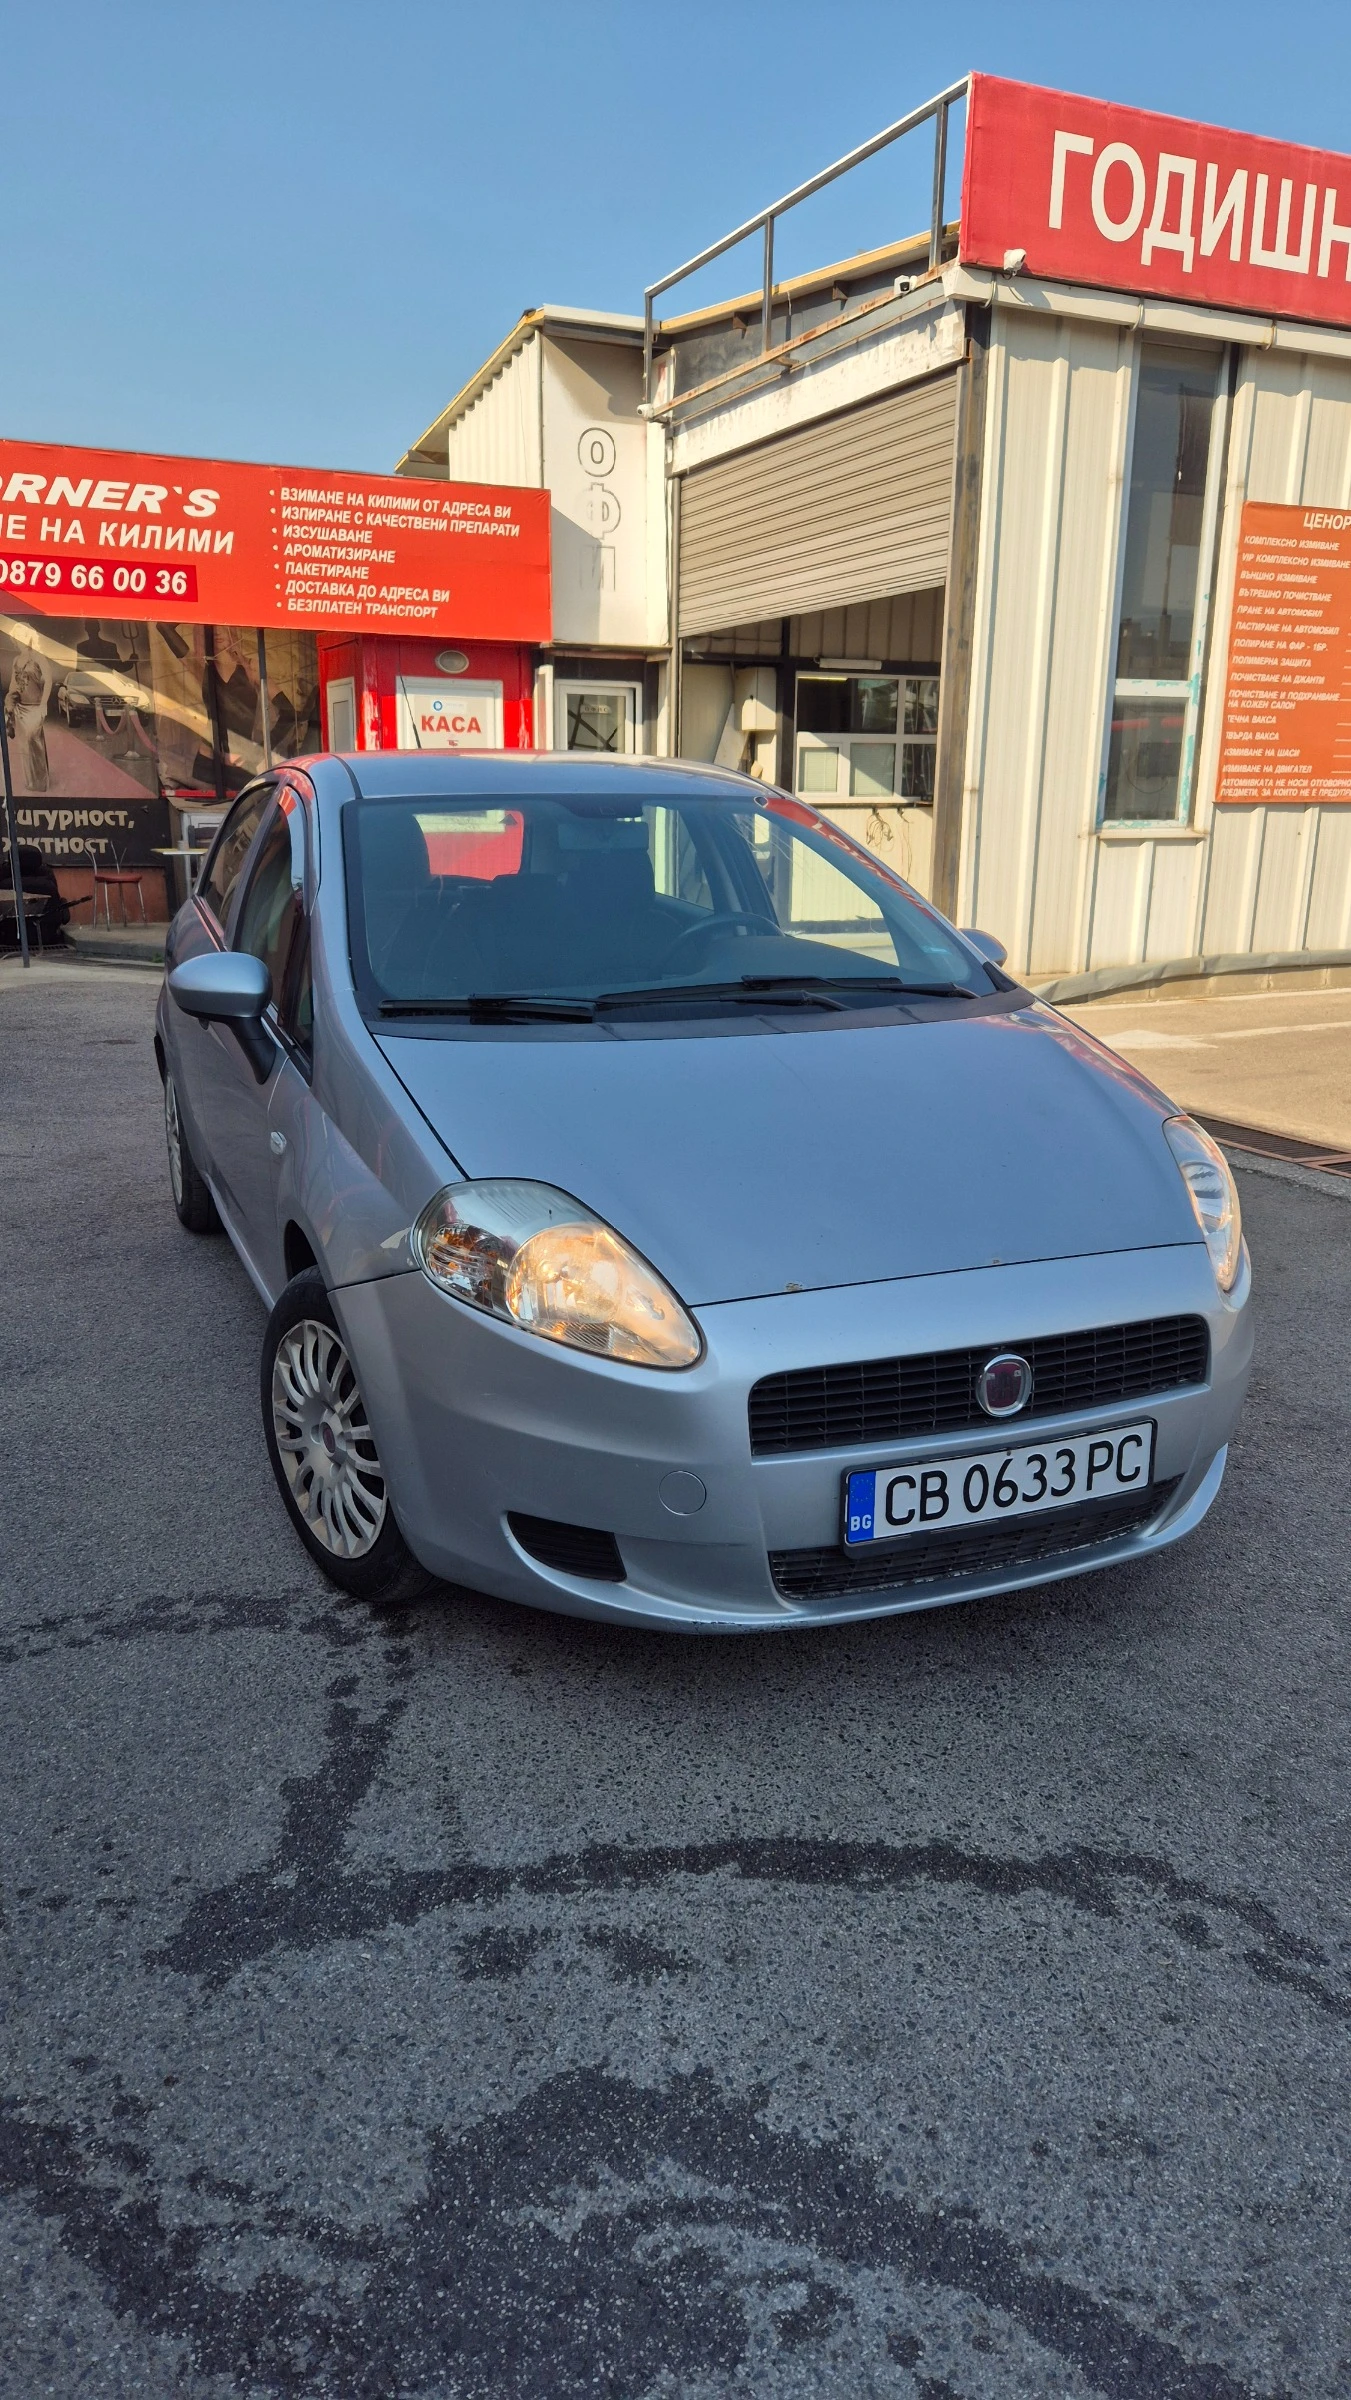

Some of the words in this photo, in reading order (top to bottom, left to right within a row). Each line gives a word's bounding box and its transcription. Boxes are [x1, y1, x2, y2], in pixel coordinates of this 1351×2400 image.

[1048, 130, 1351, 282] ГОДИШН
[0, 472, 221, 518] RNER`S
[280, 487, 344, 505] ВЗИМАНЕ
[347, 493, 364, 507] НА
[368, 494, 420, 511] КИЛИМИ
[422, 500, 440, 513] ОТ
[442, 502, 491, 517] АДРЕСА
[494, 505, 512, 519] ВИ
[281, 506, 351, 524] ИЗПИРАНЕ
[354, 511, 364, 524] С
[366, 514, 447, 532] КАЧЕСТВЕНИ
[450, 520, 520, 537] ПРЕПАРАТИ
[40, 517, 85, 545] НА
[98, 522, 235, 555] КИЛИМИ
[283, 525, 373, 543] ИЗСУШАВАНЕ
[1244, 535, 1298, 548] КОМПЛЕКСНО
[1299, 540, 1340, 551] ИЗМИВАНЕ
[284, 543, 396, 563] АРОМАТИЗИРАНЕ
[1256, 554, 1309, 566] КОМПЛЕКСНО
[1310, 558, 1351, 568] ИЗМИВАНЕ
[285, 562, 369, 579] ПАКЕТИРАНЕ
[1276, 573, 1318, 584] ИЗМИВАНЕ
[70, 564, 104, 590] 66
[113, 567, 146, 593] 00
[155, 570, 187, 595] 36
[285, 580, 355, 597] ДОСТАВКА
[357, 585, 377, 599] ДО
[379, 587, 429, 602] АДРЕСА
[432, 590, 450, 603] ВИ
[1239, 588, 1281, 599] ВЪТРЕШНО
[1283, 591, 1332, 602] ПОЧИСТВАНЕ
[287, 598, 362, 614] БЕЗПЛАТЕН
[365, 602, 438, 618] ТРАНСПОРТ
[1237, 605, 1263, 615] ПРАНЕ
[1264, 607, 1275, 615] НА
[1277, 608, 1323, 618] АВТОМОБИЛ
[1236, 621, 1280, 632] ПАСТИРАНЕ
[1281, 624, 1292, 633] НА
[1294, 625, 1340, 635] АВТОМОБИЛ
[1276, 641, 1287, 649] НА
[1231, 672, 1280, 683] ПОЧИСТВАНЕ
[1281, 674, 1292, 683] НА
[1229, 689, 1279, 699] ПОЧИСТВАНЕ
[1280, 691, 1286, 700] И
[1228, 700, 1239, 708] НА
[1241, 701, 1269, 709] КОЖЕН
[1271, 701, 1296, 710] САЛОН
[421, 715, 482, 734] КАСА
[1252, 715, 1277, 724] ВАКСА
[1255, 732, 1280, 740] ВАКСА
[1264, 748, 1275, 757] НА
[1262, 765, 1273, 773] НА
[1275, 779, 1287, 787] НЕ
[884, 1468, 950, 1526] CB
[963, 1447, 1076, 1513] 0633
[1086, 1434, 1143, 1492] PC
[850, 1513, 872, 1532] BG
